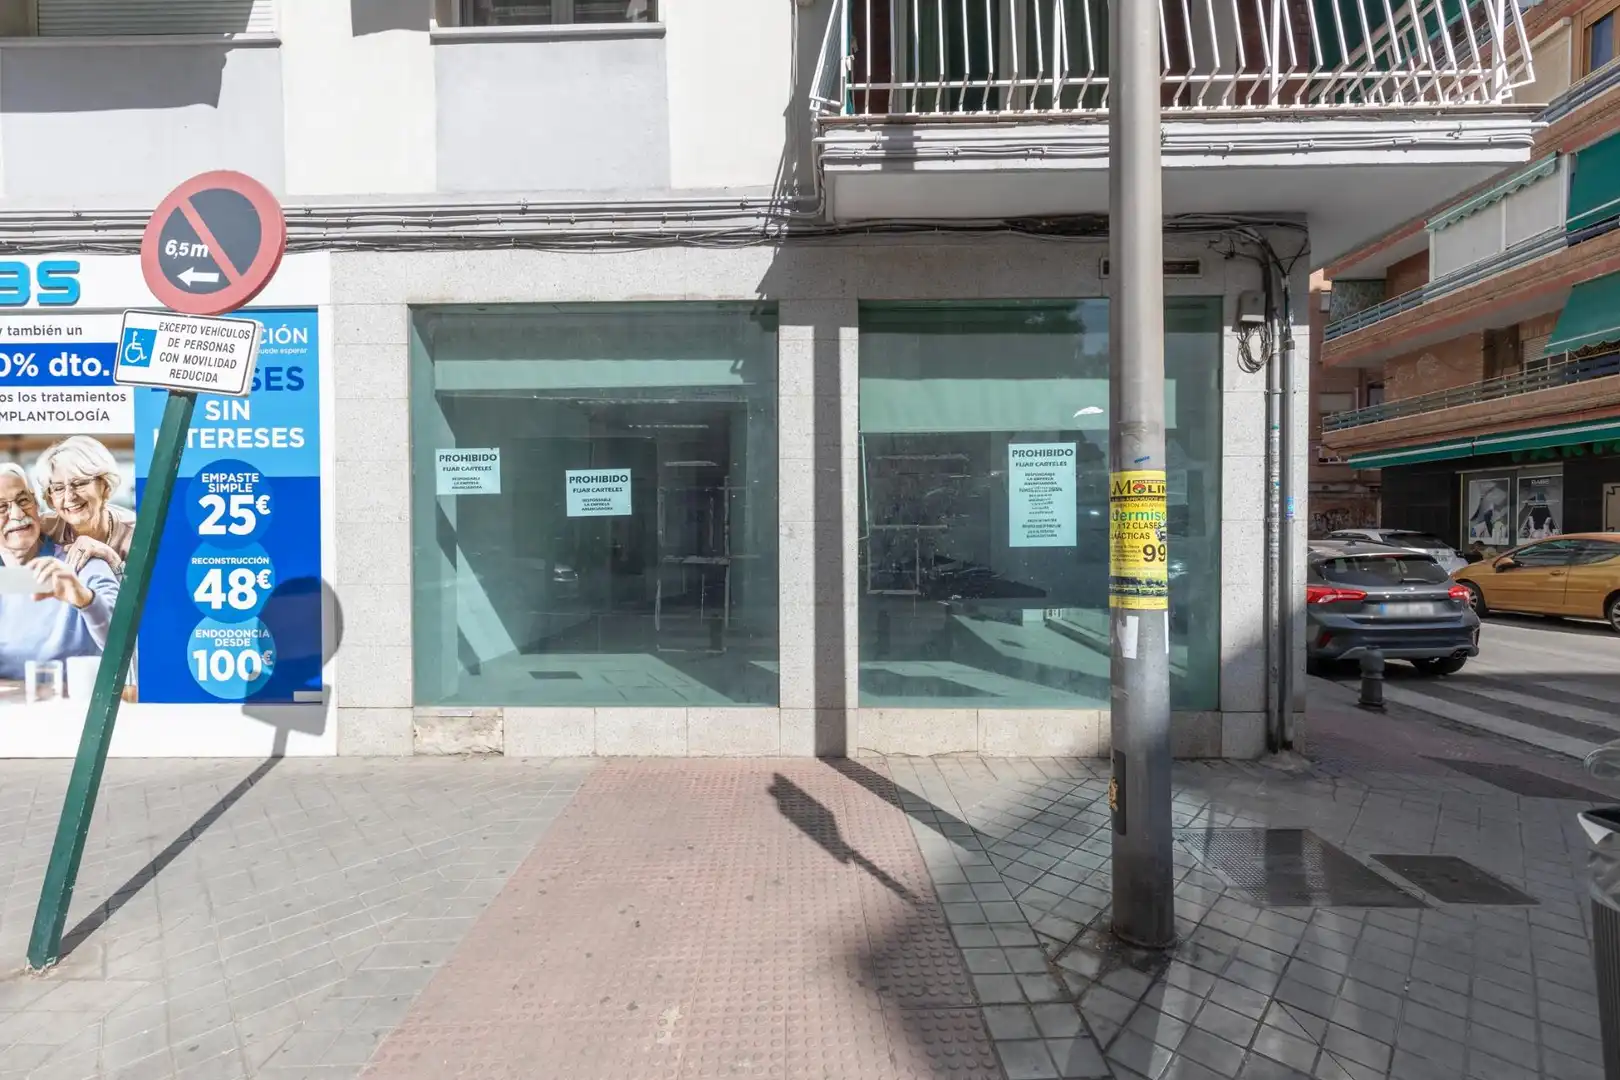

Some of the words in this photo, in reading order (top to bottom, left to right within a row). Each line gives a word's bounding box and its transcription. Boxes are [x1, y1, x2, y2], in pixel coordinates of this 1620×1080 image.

[7, 324, 62, 336] también
[66, 327, 83, 336] un
[158, 321, 198, 334] EXCEPTO
[200, 325, 251, 340] VEHÍCULOS
[167, 337, 181, 348] DE
[183, 338, 236, 354] PERSONAS
[48, 351, 110, 377] dto.
[159, 351, 180, 363] CON
[182, 353, 237, 370] MOVILIDAD
[169, 368, 218, 383] REDUCIDA
[18, 391, 37, 403] los
[41, 391, 127, 403] tratamientos
[205, 400, 251, 421] SIN
[153, 427, 306, 449] ITERESES
[439, 453, 498, 462] PROHIBIDO
[1012, 448, 1074, 458] PROHIBIDO
[201, 472, 260, 483] EMPASTE
[569, 474, 629, 484] PROHIBIDO
[208, 483, 253, 493] SIMPLE
[1132, 521, 1163, 530] CLASES
[191, 556, 270, 565] RECONSTRUCCIÓN
[195, 629, 271, 638] ENDODONCIA
[215, 638, 251, 647] DESDE
